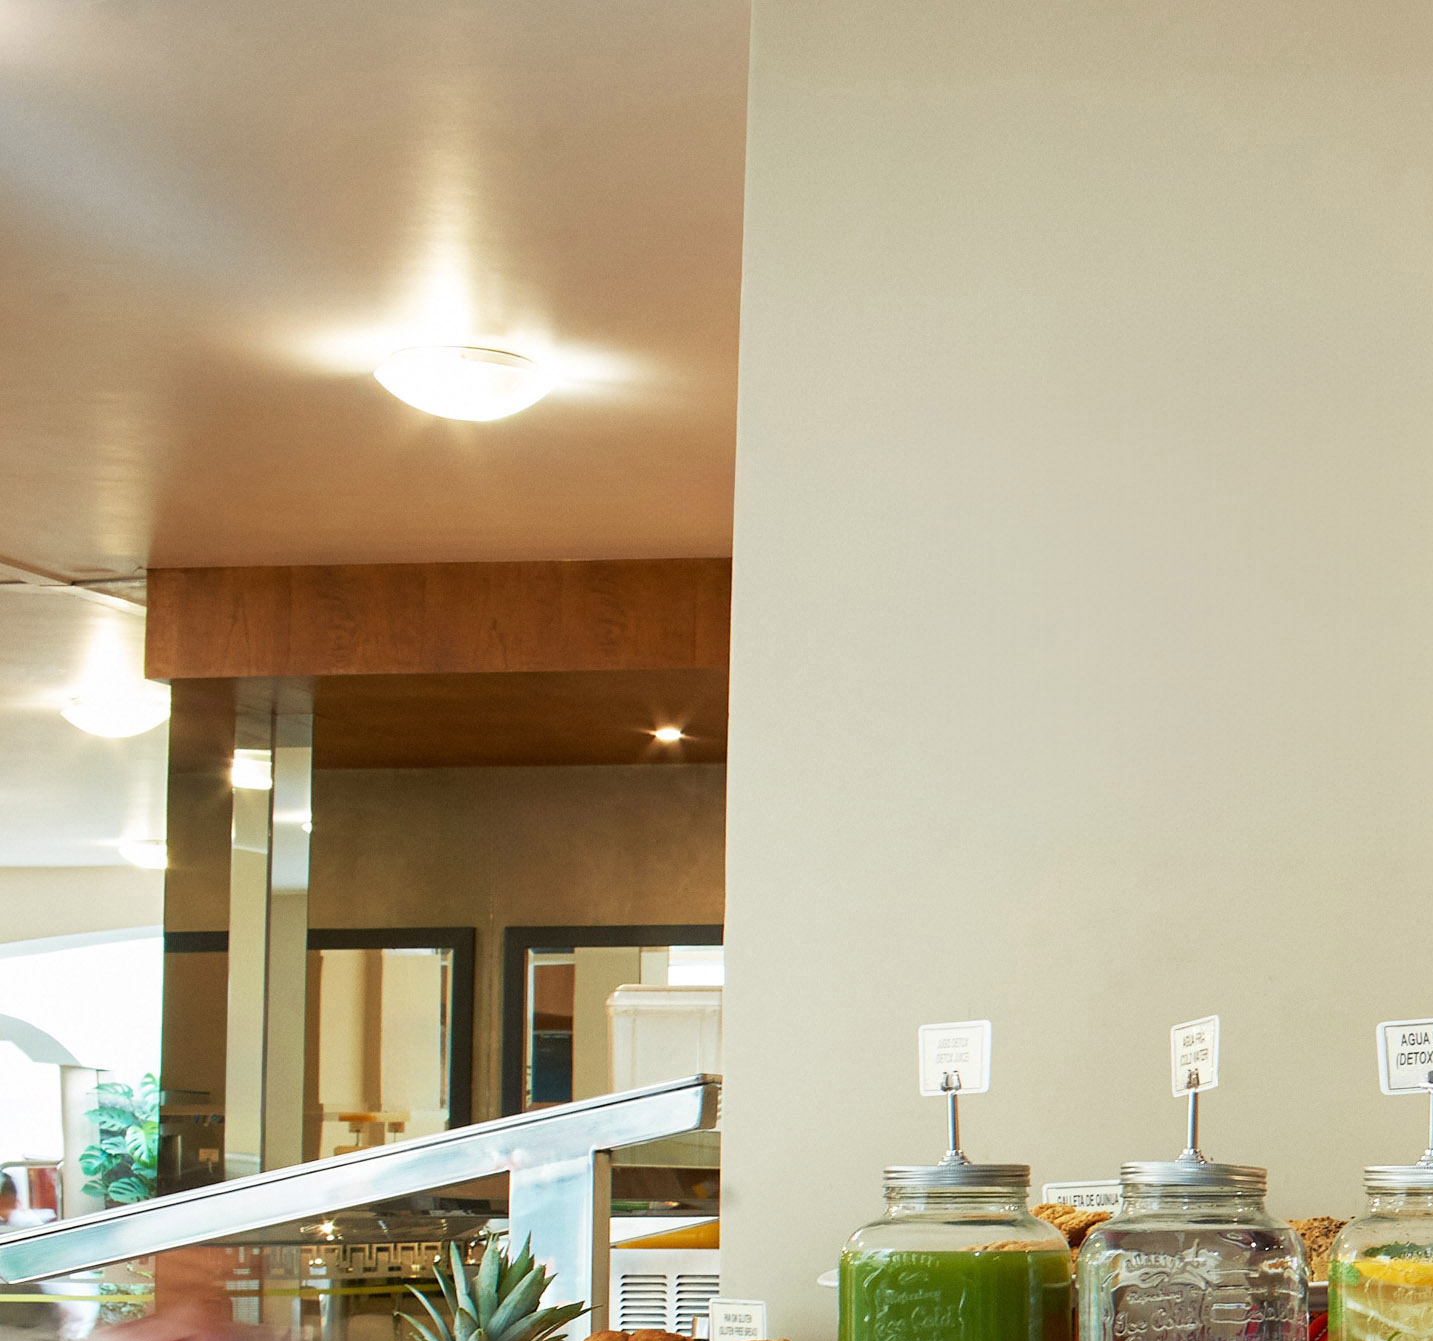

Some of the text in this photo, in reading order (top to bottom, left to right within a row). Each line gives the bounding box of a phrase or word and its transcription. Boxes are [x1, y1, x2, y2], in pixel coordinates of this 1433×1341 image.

[1401, 1031, 1430, 1046] AGUA
[1396, 1050, 1433, 1070] (DETOX
[1086, 1194, 1094, 1206] DE
